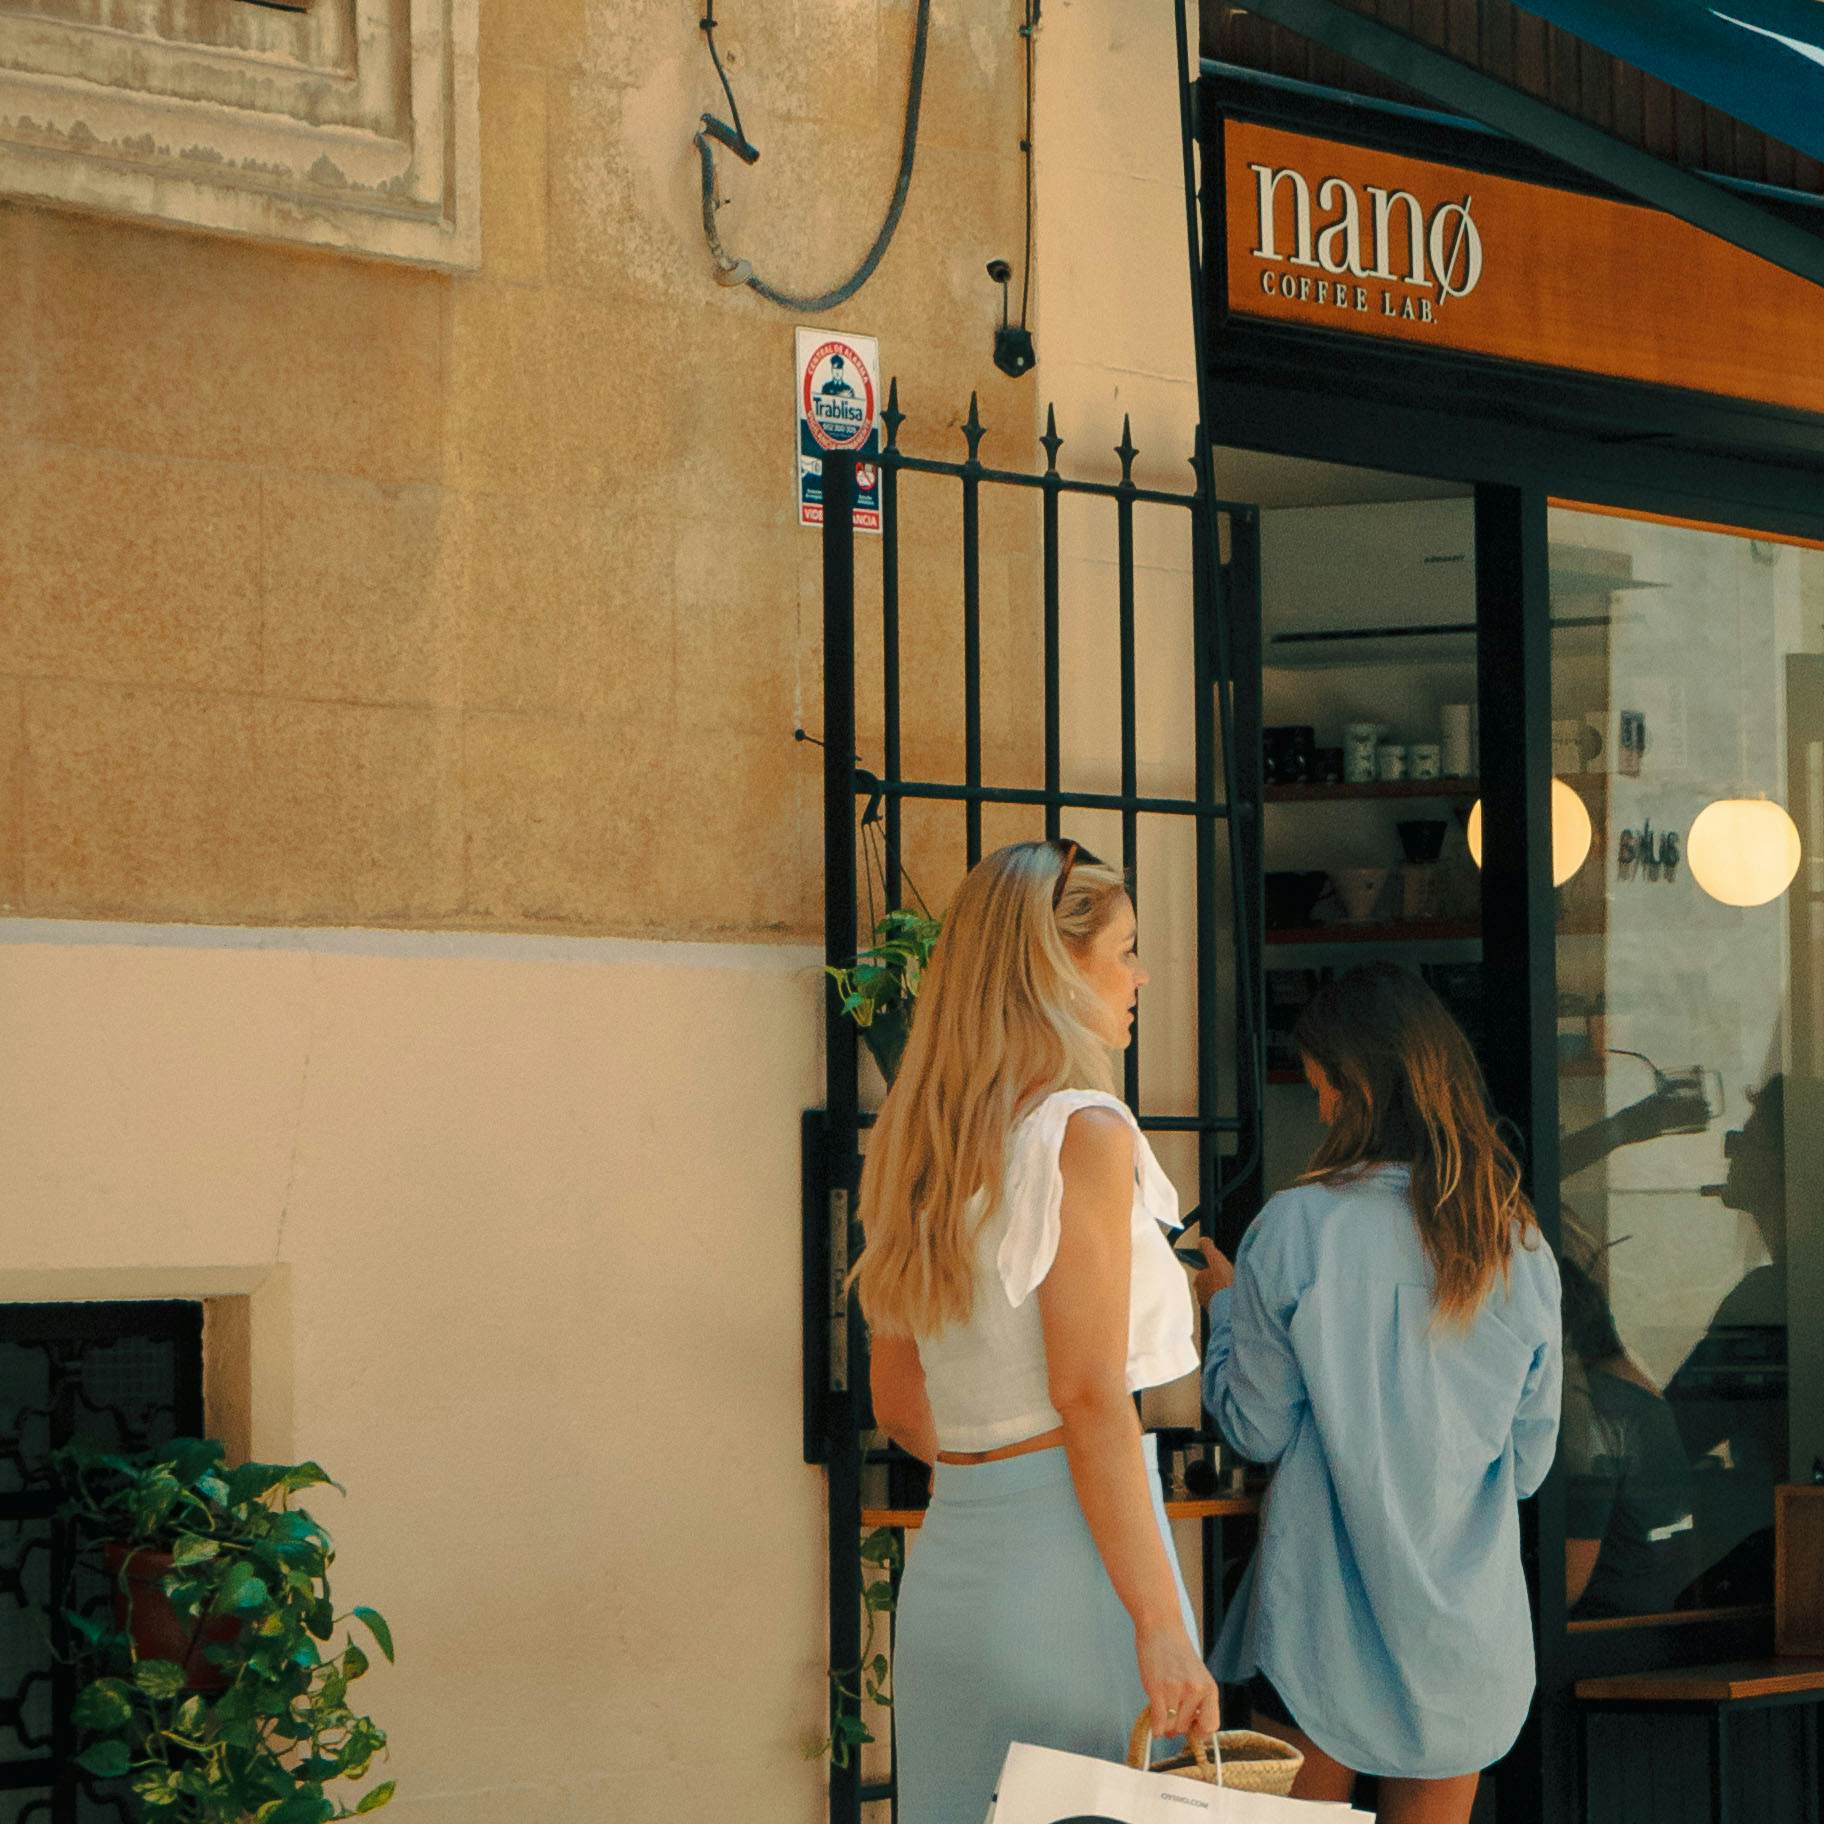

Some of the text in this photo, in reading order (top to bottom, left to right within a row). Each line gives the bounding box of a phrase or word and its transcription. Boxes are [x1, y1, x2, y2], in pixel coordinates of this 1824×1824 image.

[1261, 270, 1438, 325] COFFEE LAB.
[813, 396, 863, 421] Trablisa
